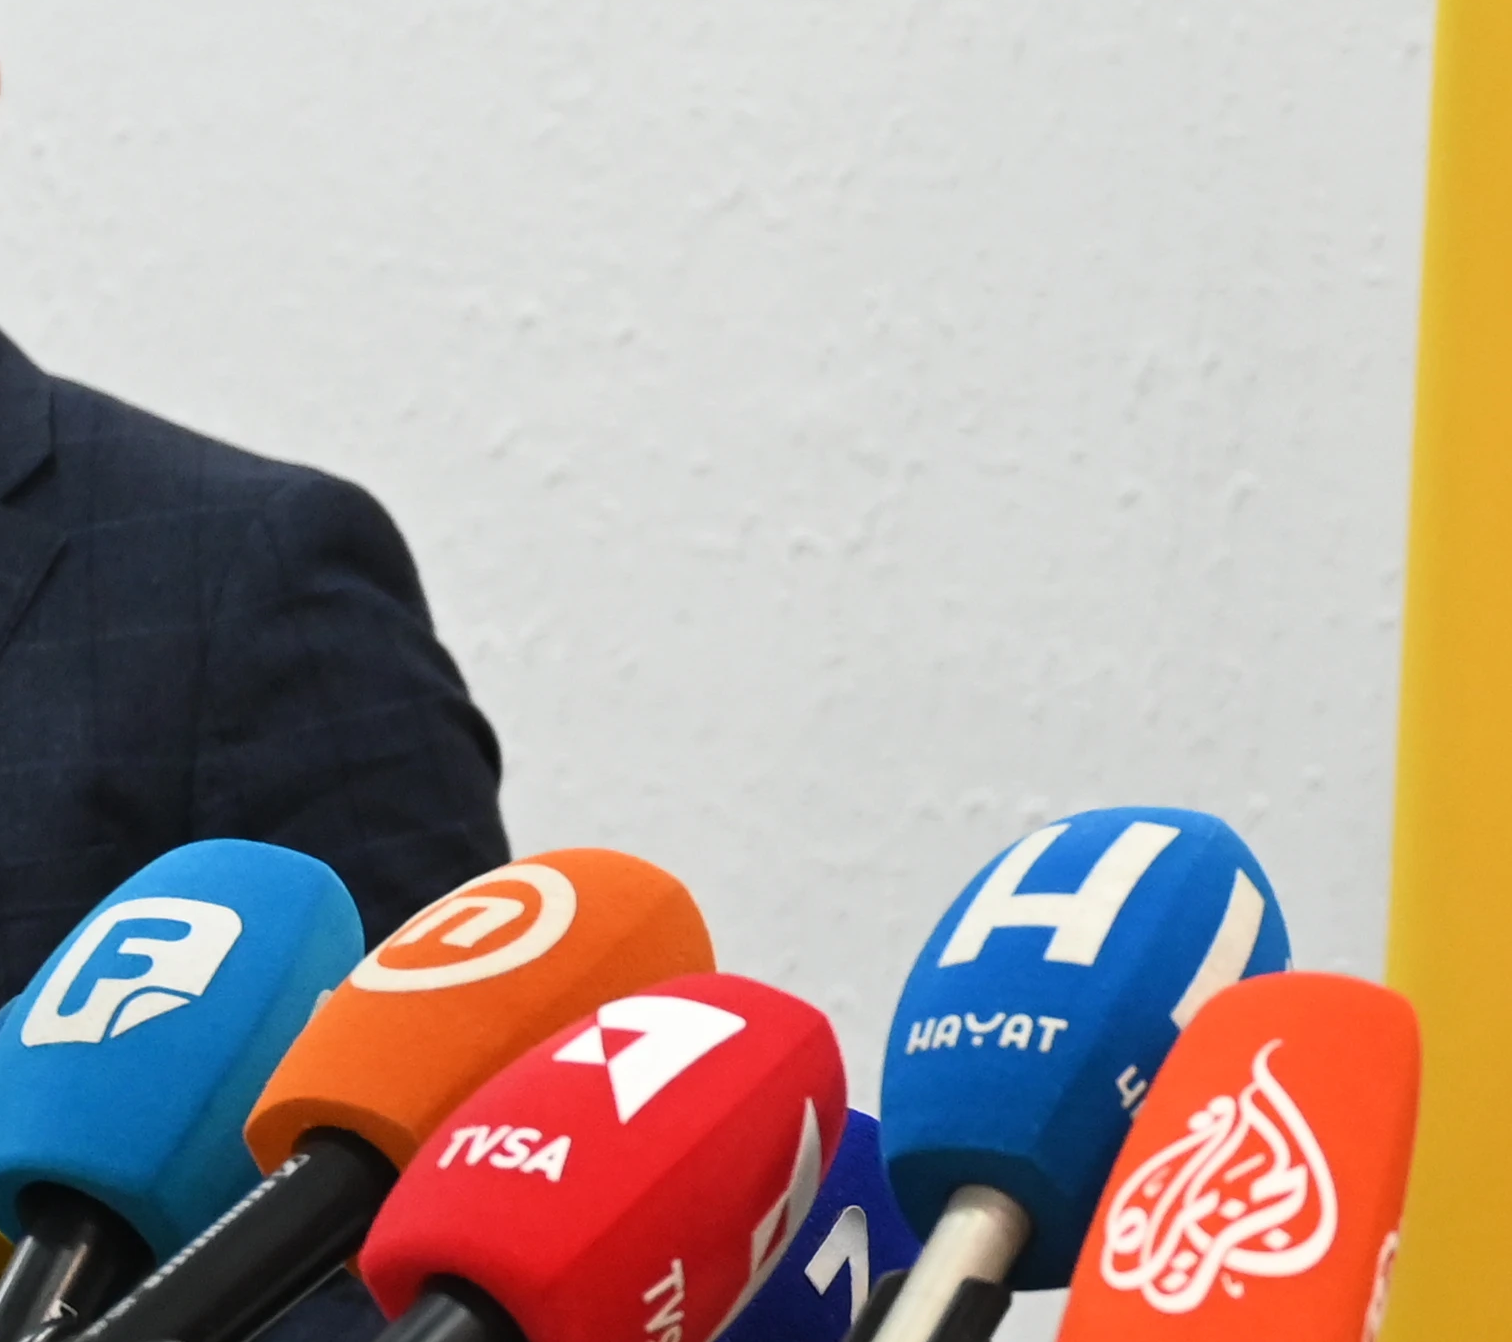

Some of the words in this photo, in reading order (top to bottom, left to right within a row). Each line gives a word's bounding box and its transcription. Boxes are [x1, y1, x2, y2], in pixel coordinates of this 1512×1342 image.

[937, 821, 1182, 968] H
[905, 1012, 1069, 1054] HAYAT
[437, 1124, 572, 1182] TVSA
